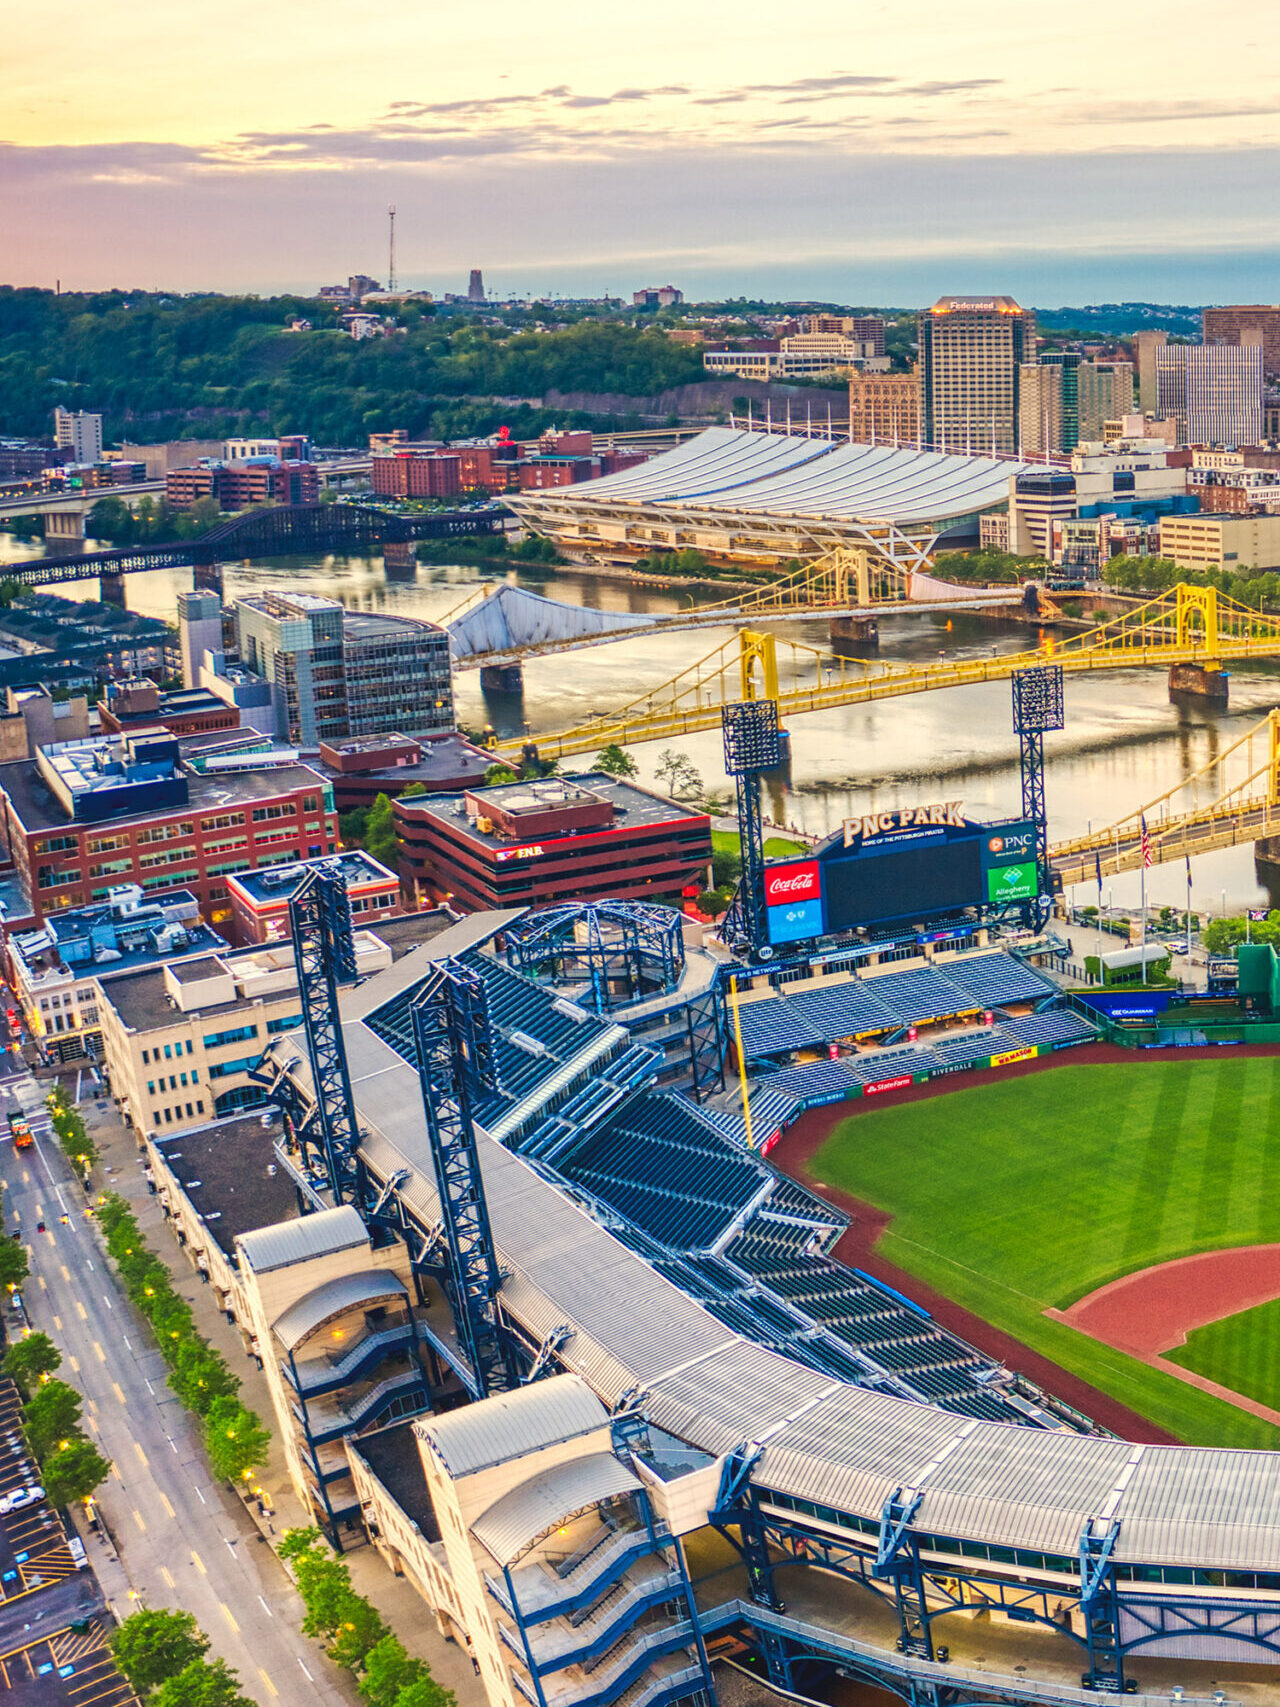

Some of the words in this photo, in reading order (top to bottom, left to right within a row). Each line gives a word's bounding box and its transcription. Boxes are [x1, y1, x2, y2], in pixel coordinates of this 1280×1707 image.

[950, 301, 994, 310] Federated
[843, 812, 896, 849] PNC
[899, 800, 967, 829] PARK
[861, 839, 876, 847] HOME
[894, 832, 924, 841] PITTSBURGH
[924, 828, 945, 836] PIRATES
[1004, 833, 1033, 849] PNC
[996, 885, 1031, 896] Allegheny
[752, 965, 782, 976] NETWORK
